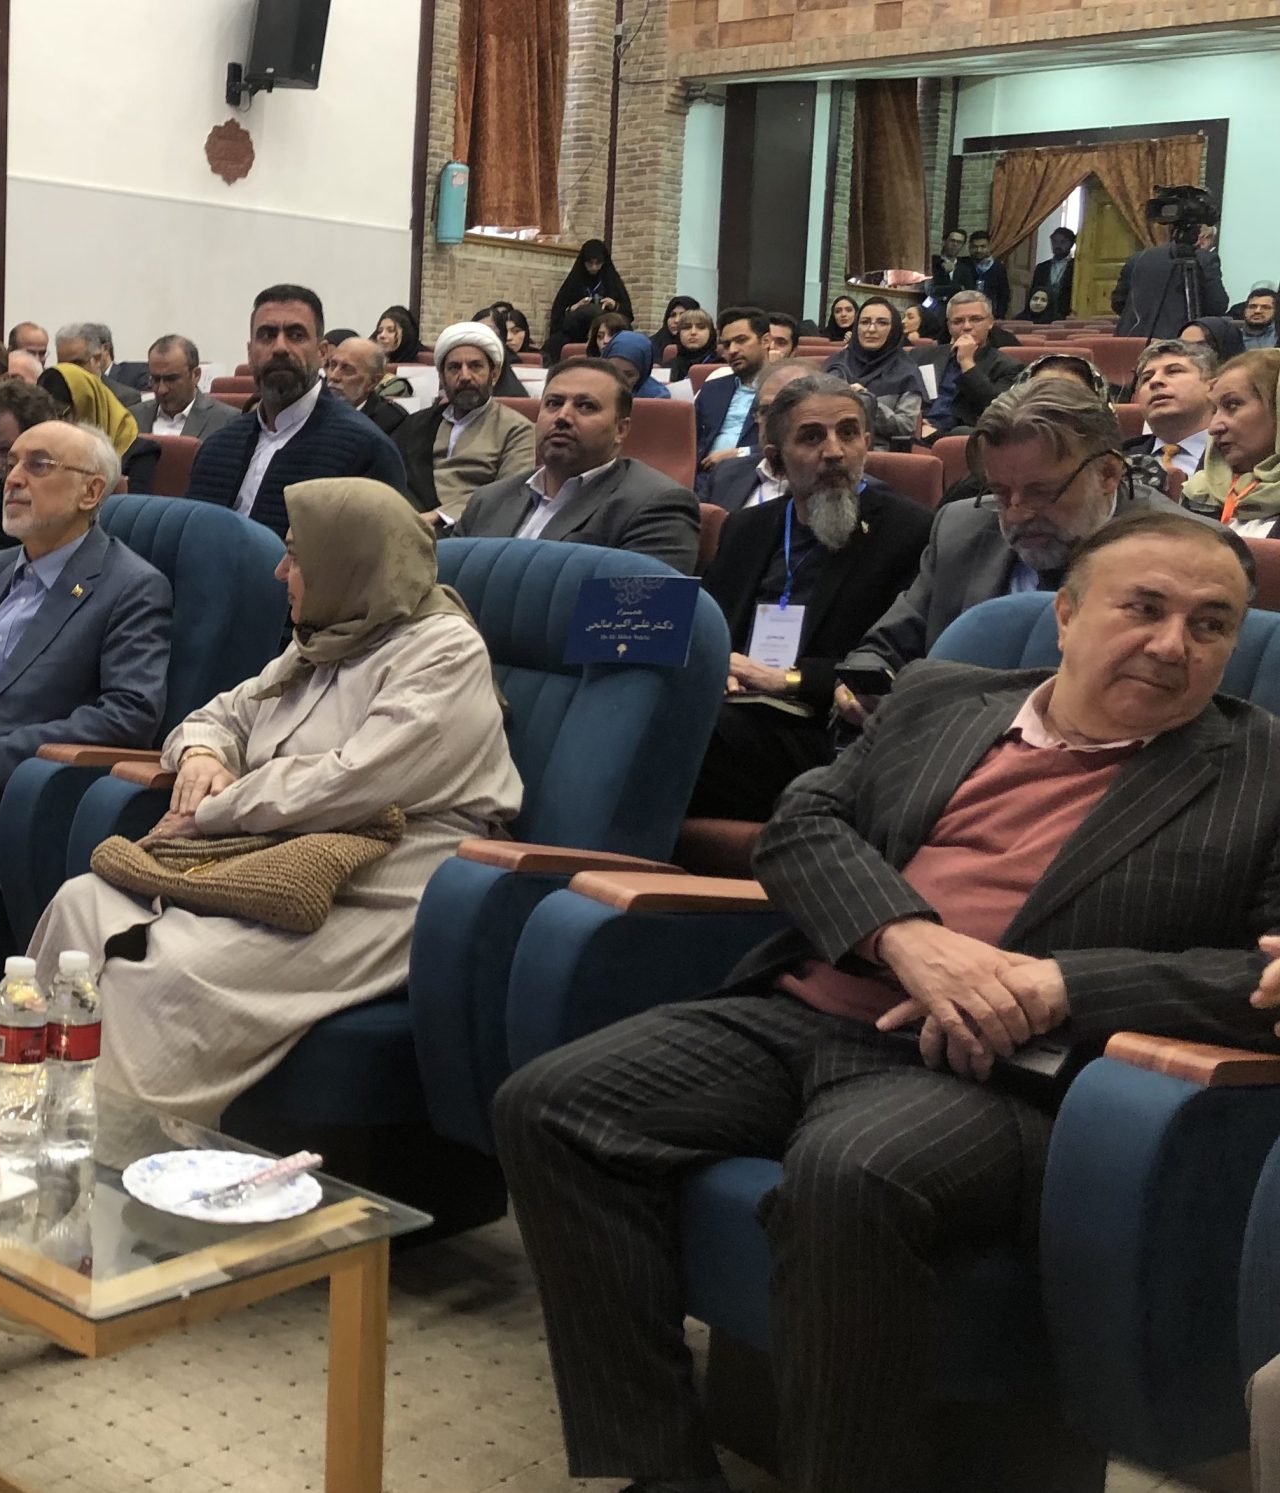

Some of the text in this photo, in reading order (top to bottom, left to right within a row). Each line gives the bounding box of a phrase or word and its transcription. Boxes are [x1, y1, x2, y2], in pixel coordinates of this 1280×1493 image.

[585, 618, 674, 632] دکتر علی اکبر صالحی
